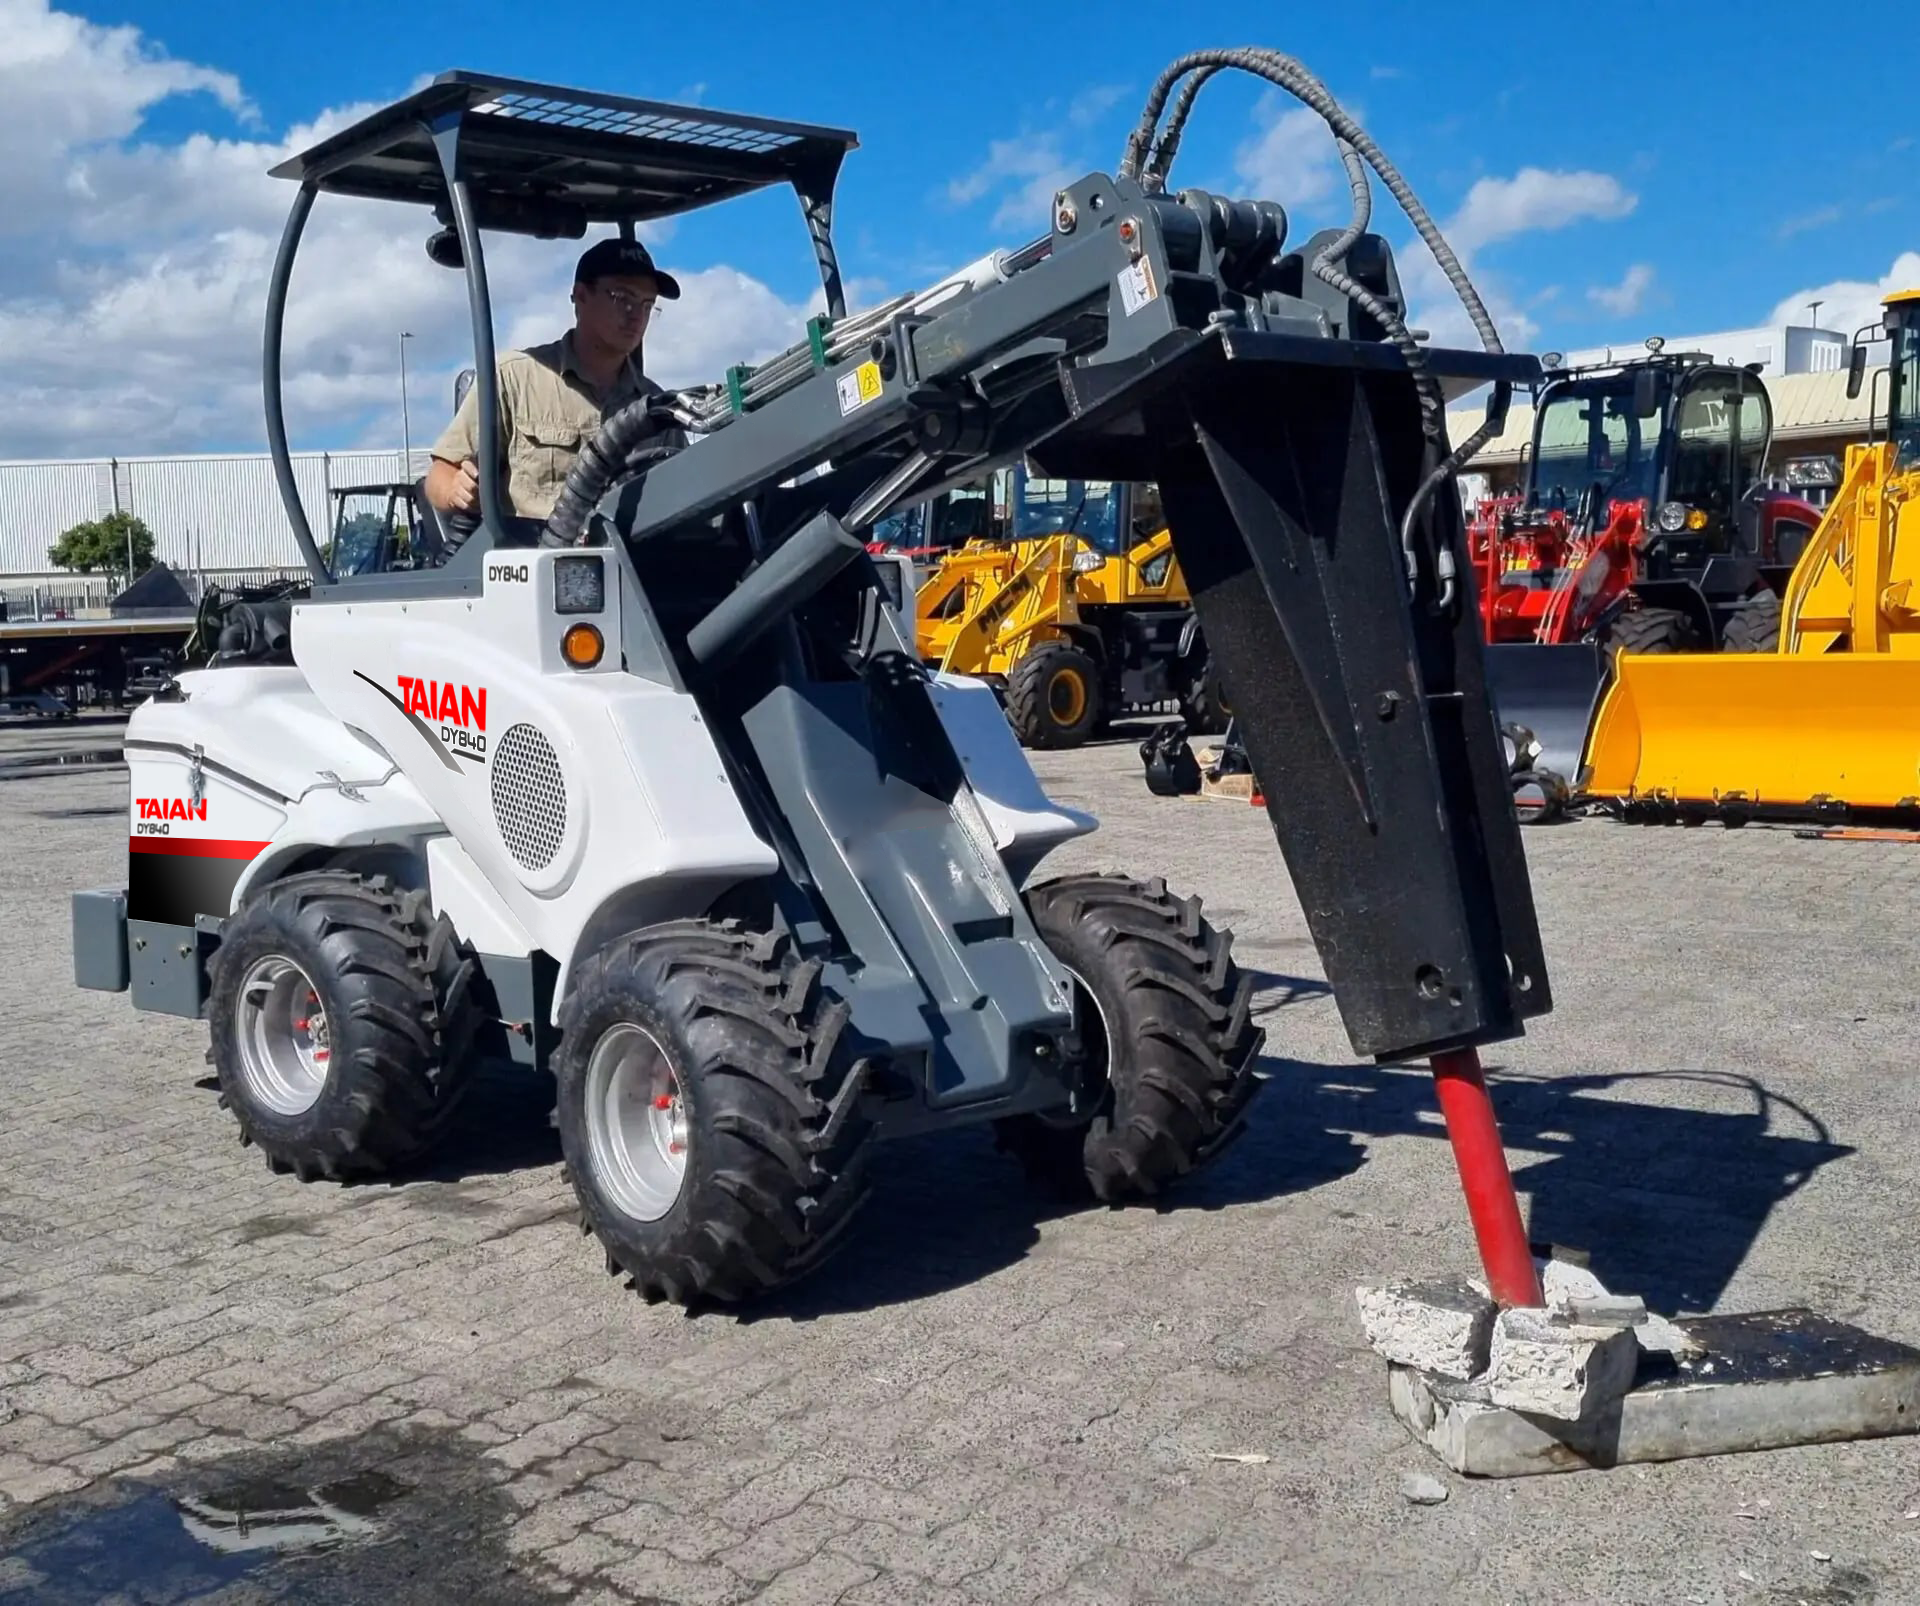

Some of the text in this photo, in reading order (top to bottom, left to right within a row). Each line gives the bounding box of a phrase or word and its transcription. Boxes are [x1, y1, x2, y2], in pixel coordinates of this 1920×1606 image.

[489, 565, 528, 583] DY840
[397, 674, 487, 733] TAIAN
[441, 725, 487, 753] DY840
[136, 798, 207, 822] TAIAN
[137, 822, 170, 835] DY840
